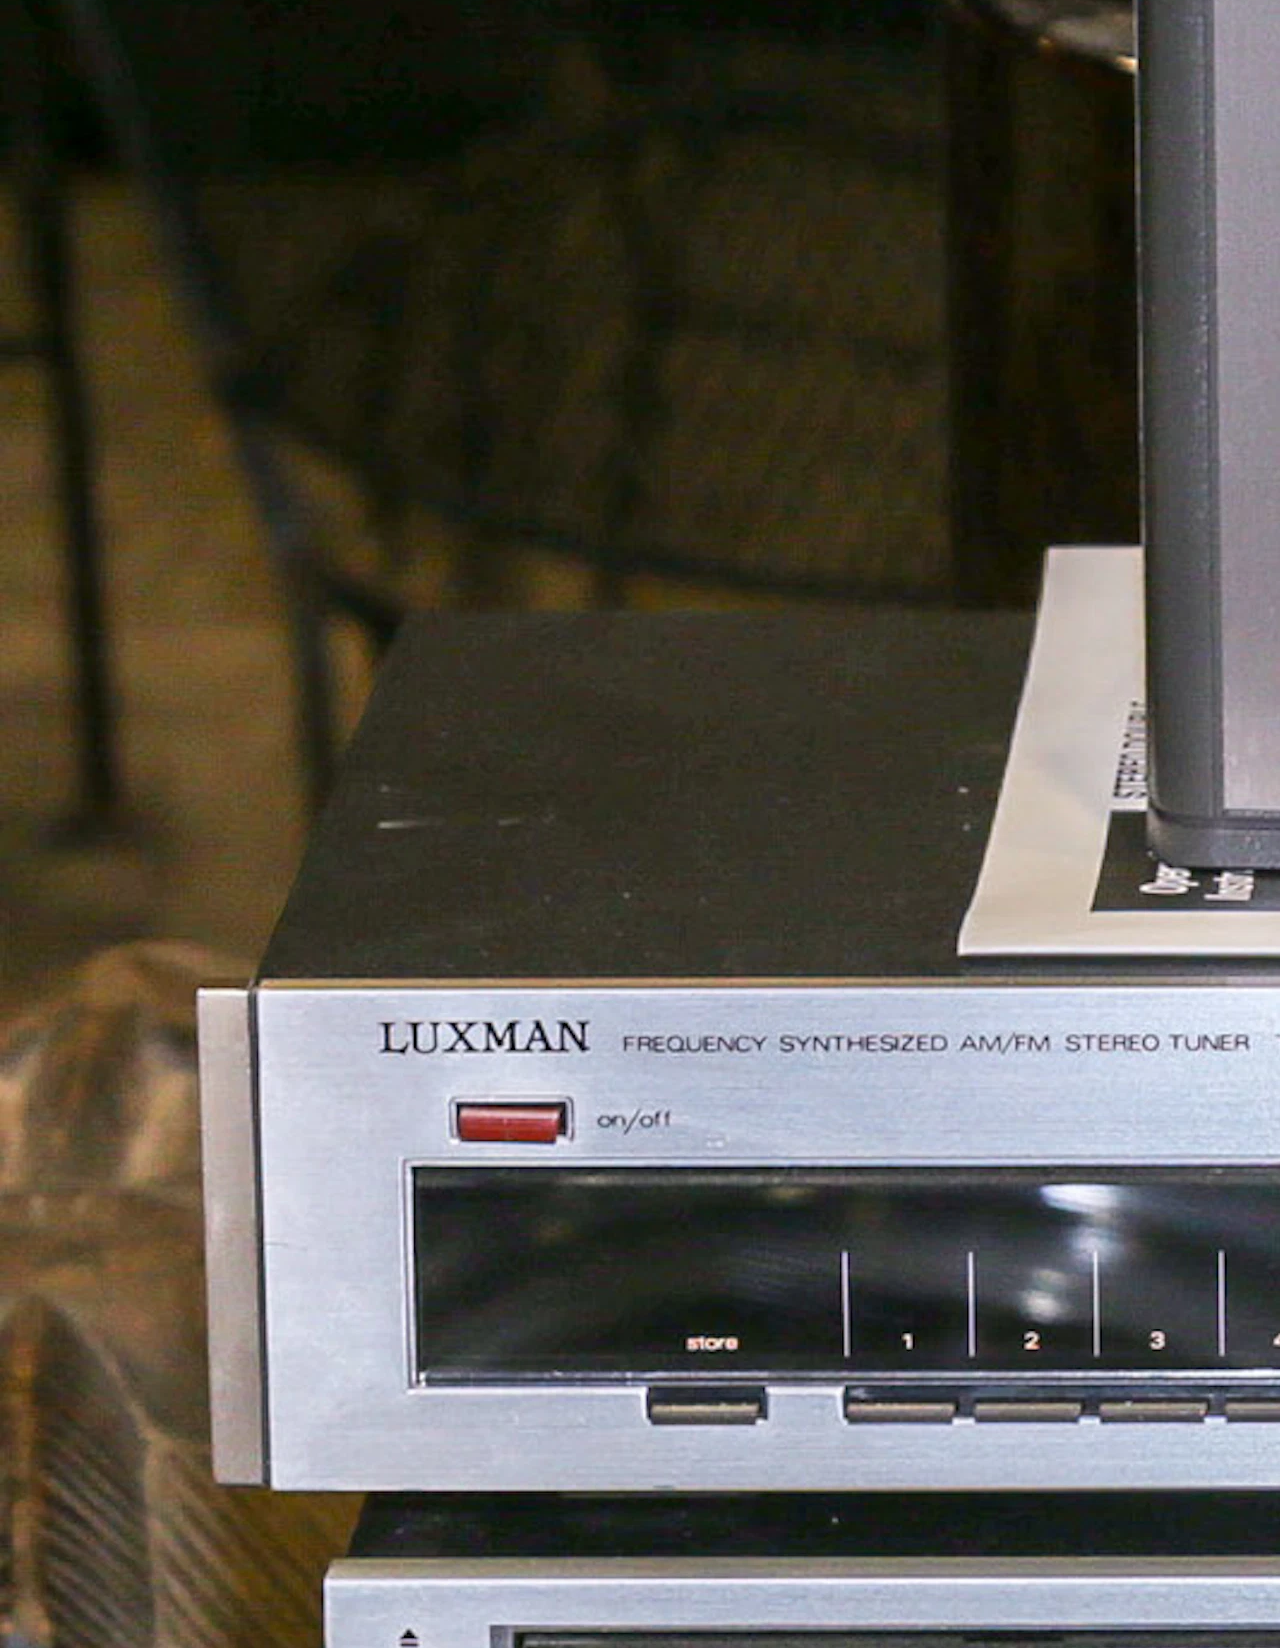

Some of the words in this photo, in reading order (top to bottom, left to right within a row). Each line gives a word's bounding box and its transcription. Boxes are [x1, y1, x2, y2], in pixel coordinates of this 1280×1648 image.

[380, 1019, 590, 1055] LUXMAN
[622, 1035, 767, 1054] FREQUENCY
[779, 1034, 949, 1054] SYNTHESIZED
[959, 1032, 1051, 1055] AM/FM
[1065, 1033, 1160, 1053] STEREO
[1169, 1033, 1250, 1052] TUNER
[596, 1109, 671, 1136] on/off
[686, 1336, 739, 1351] store
[902, 1333, 913, 1350] 1
[1024, 1331, 1040, 1350] 2
[1150, 1330, 1166, 1350] 3
